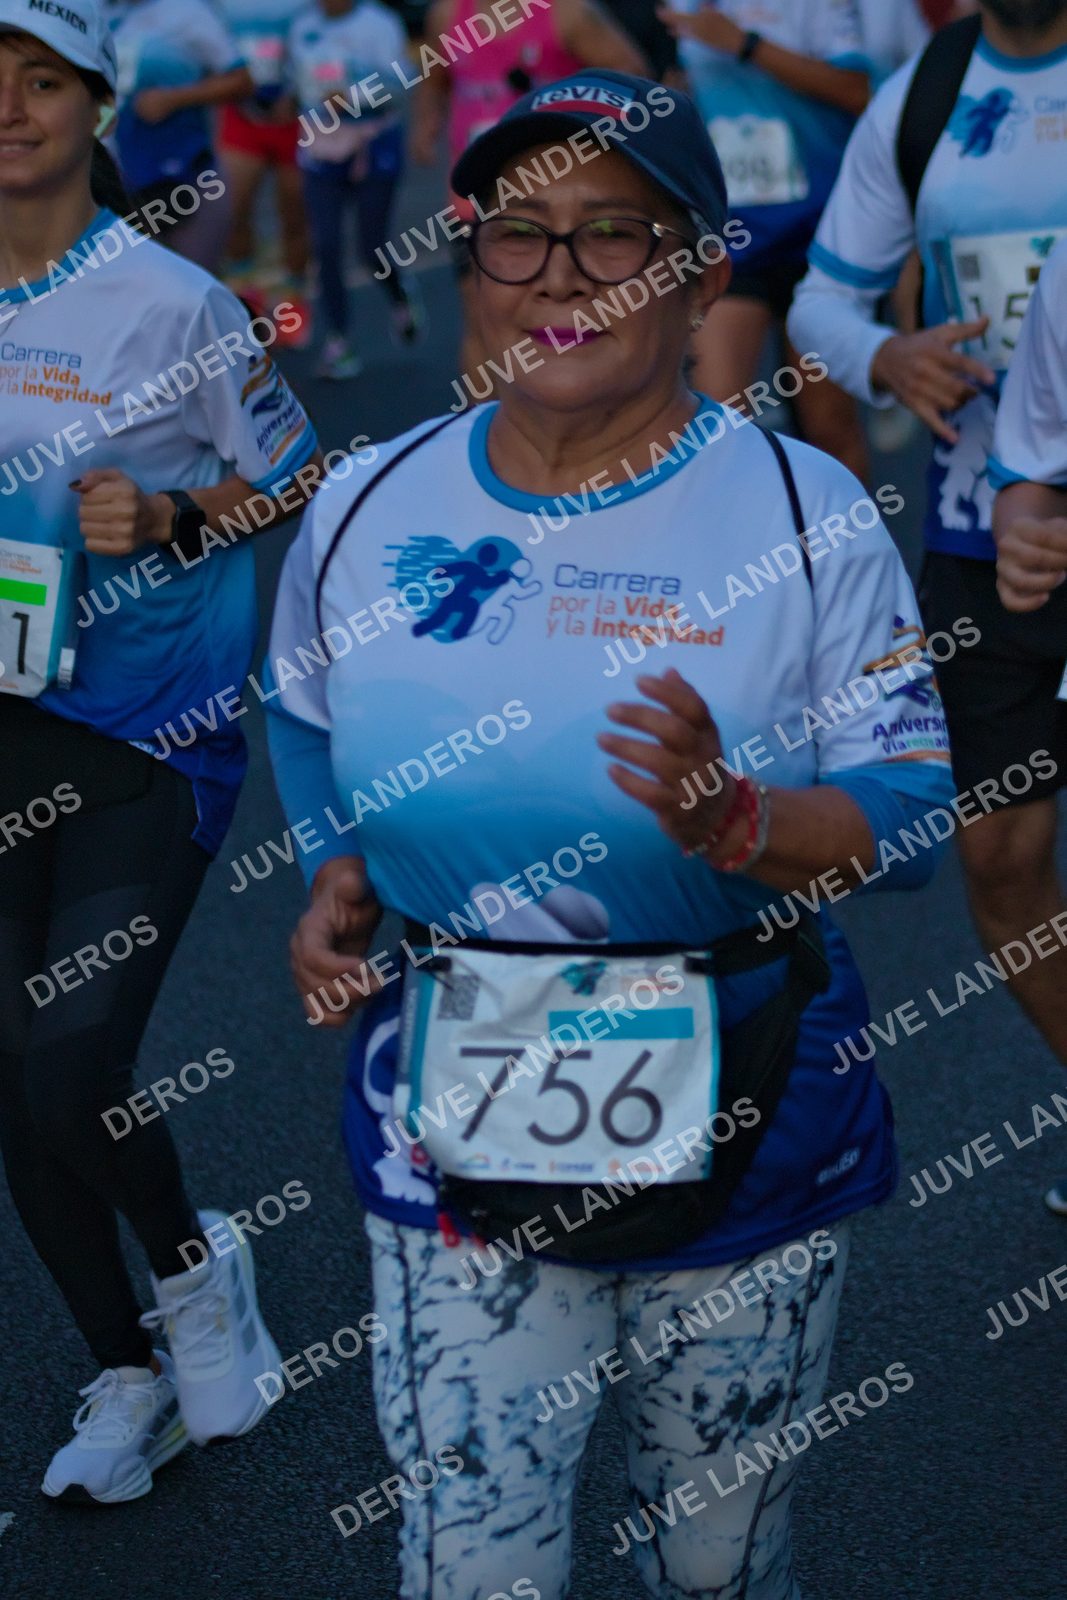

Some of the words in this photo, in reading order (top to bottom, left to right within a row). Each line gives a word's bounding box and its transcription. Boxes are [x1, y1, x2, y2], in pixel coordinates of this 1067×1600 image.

[1, 343, 82, 368] Carrera
[43, 366, 80, 386] Vida
[22, 381, 112, 406] Integridad
[554, 563, 681, 596] Carrera
[549, 596, 591, 616] por
[596, 594, 616, 616] la
[624, 596, 680, 619] Vida
[547, 617, 560, 638] y
[565, 613, 585, 635] la
[592, 616, 726, 647] Integridad
[460, 1046, 663, 1148] 756
